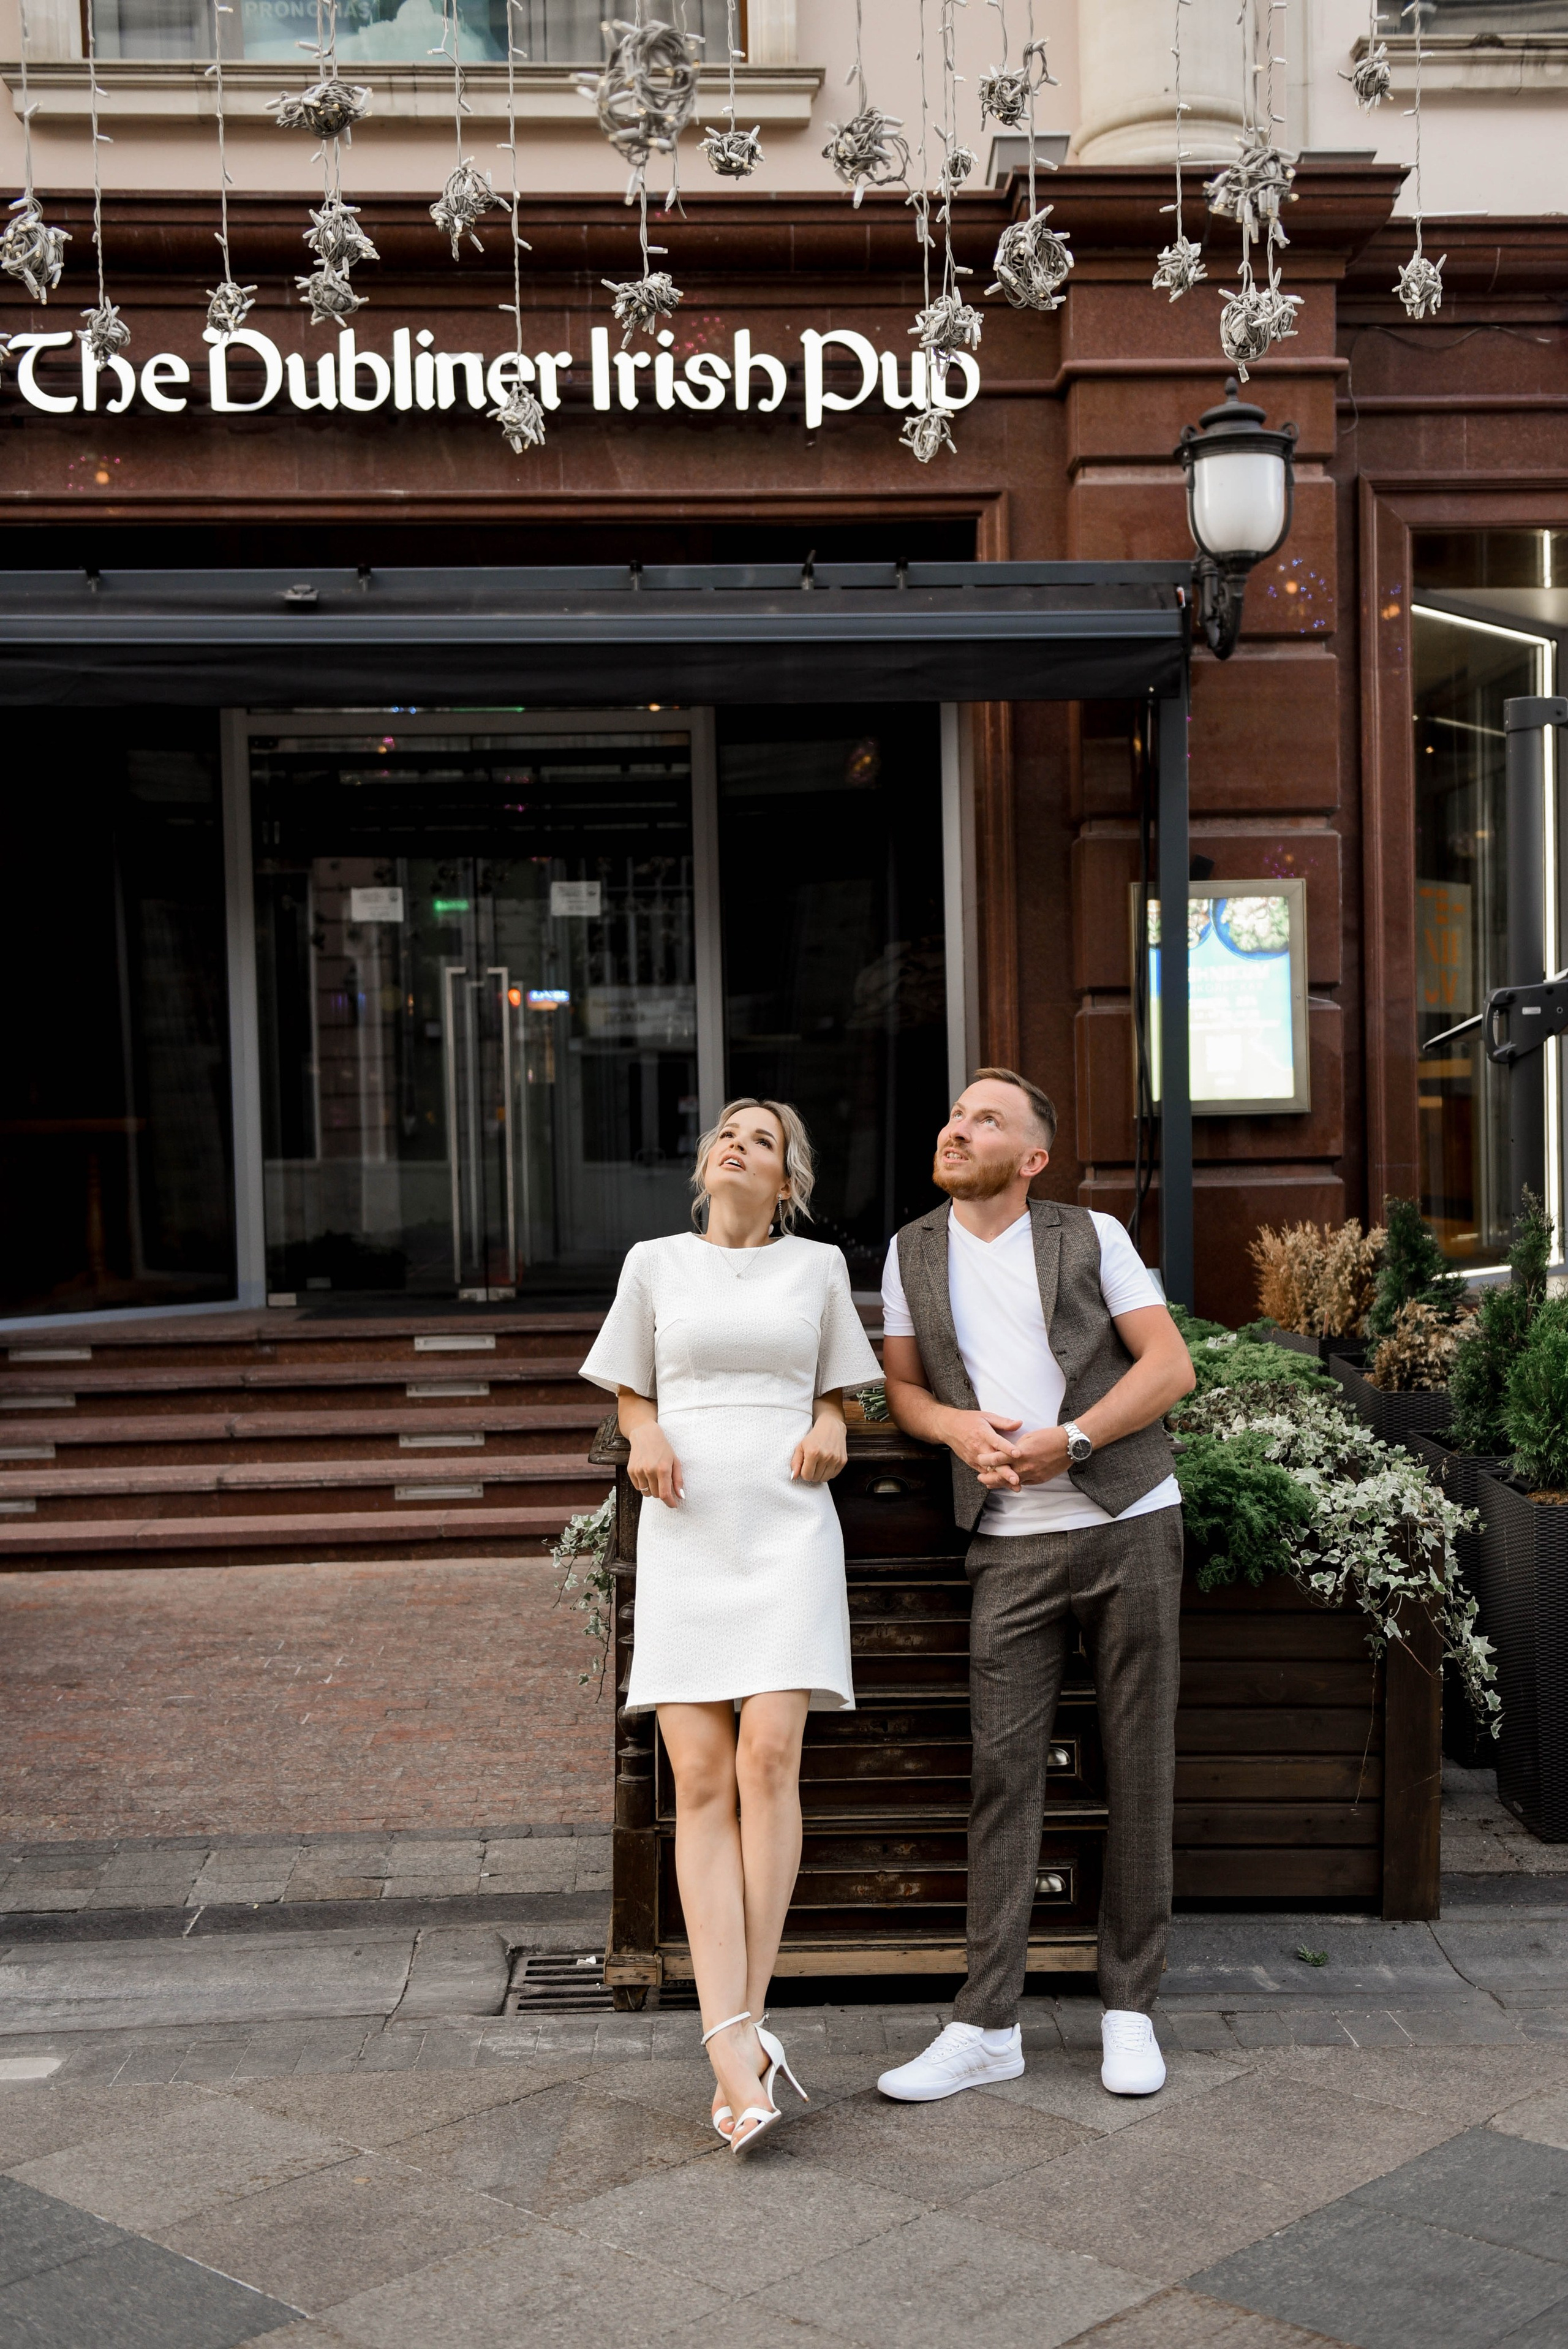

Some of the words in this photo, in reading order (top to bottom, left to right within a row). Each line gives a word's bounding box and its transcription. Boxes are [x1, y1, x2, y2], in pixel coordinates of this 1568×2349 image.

[7, 331, 189, 412] The
[202, 327, 572, 412] Dubliner
[591, 327, 787, 412] Irish
[801, 328, 980, 428] Pub
